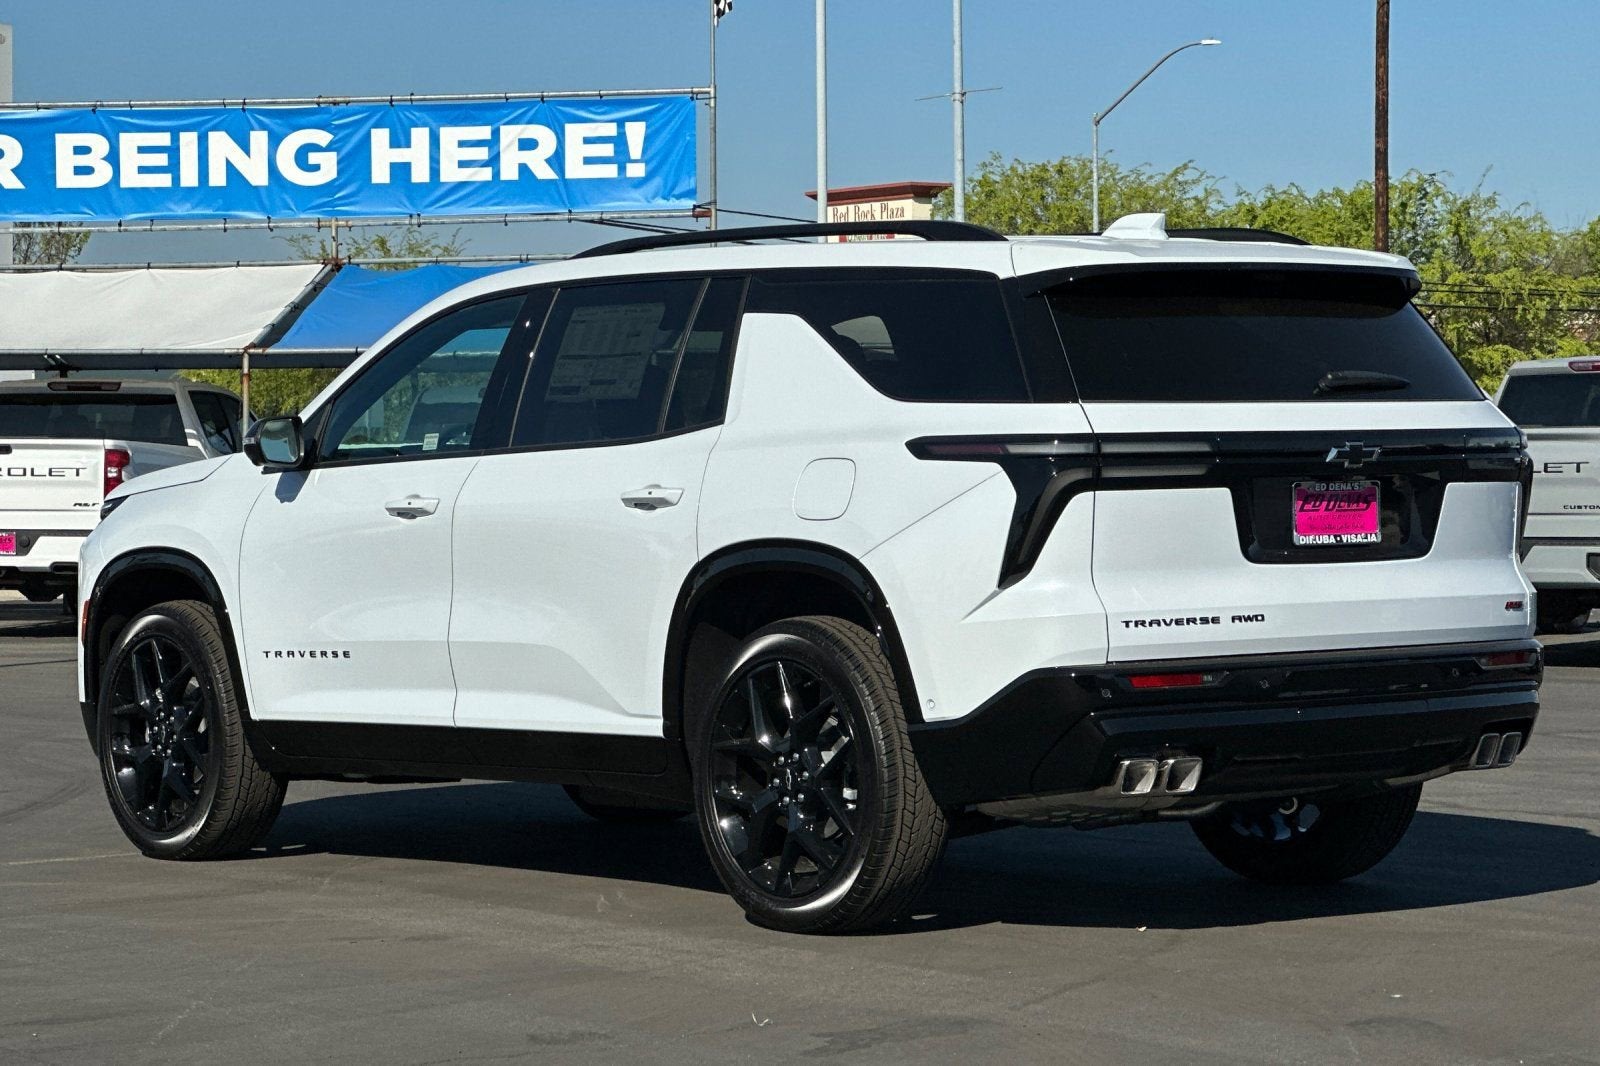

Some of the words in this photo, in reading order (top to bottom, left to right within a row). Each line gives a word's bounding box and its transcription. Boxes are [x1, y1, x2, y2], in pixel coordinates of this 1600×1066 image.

[54, 128, 338, 190] BEING
[370, 121, 647, 184] HERE!
[832, 206, 849, 222] Red
[854, 204, 876, 222] Rock
[880, 202, 905, 219] Plaza
[0, 467, 88, 477] OLET
[1315, 483, 1327, 491] ED
[1121, 616, 1221, 628] TRAVERSE
[1231, 614, 1265, 623] AWD
[263, 650, 351, 659] TRAVERSE
